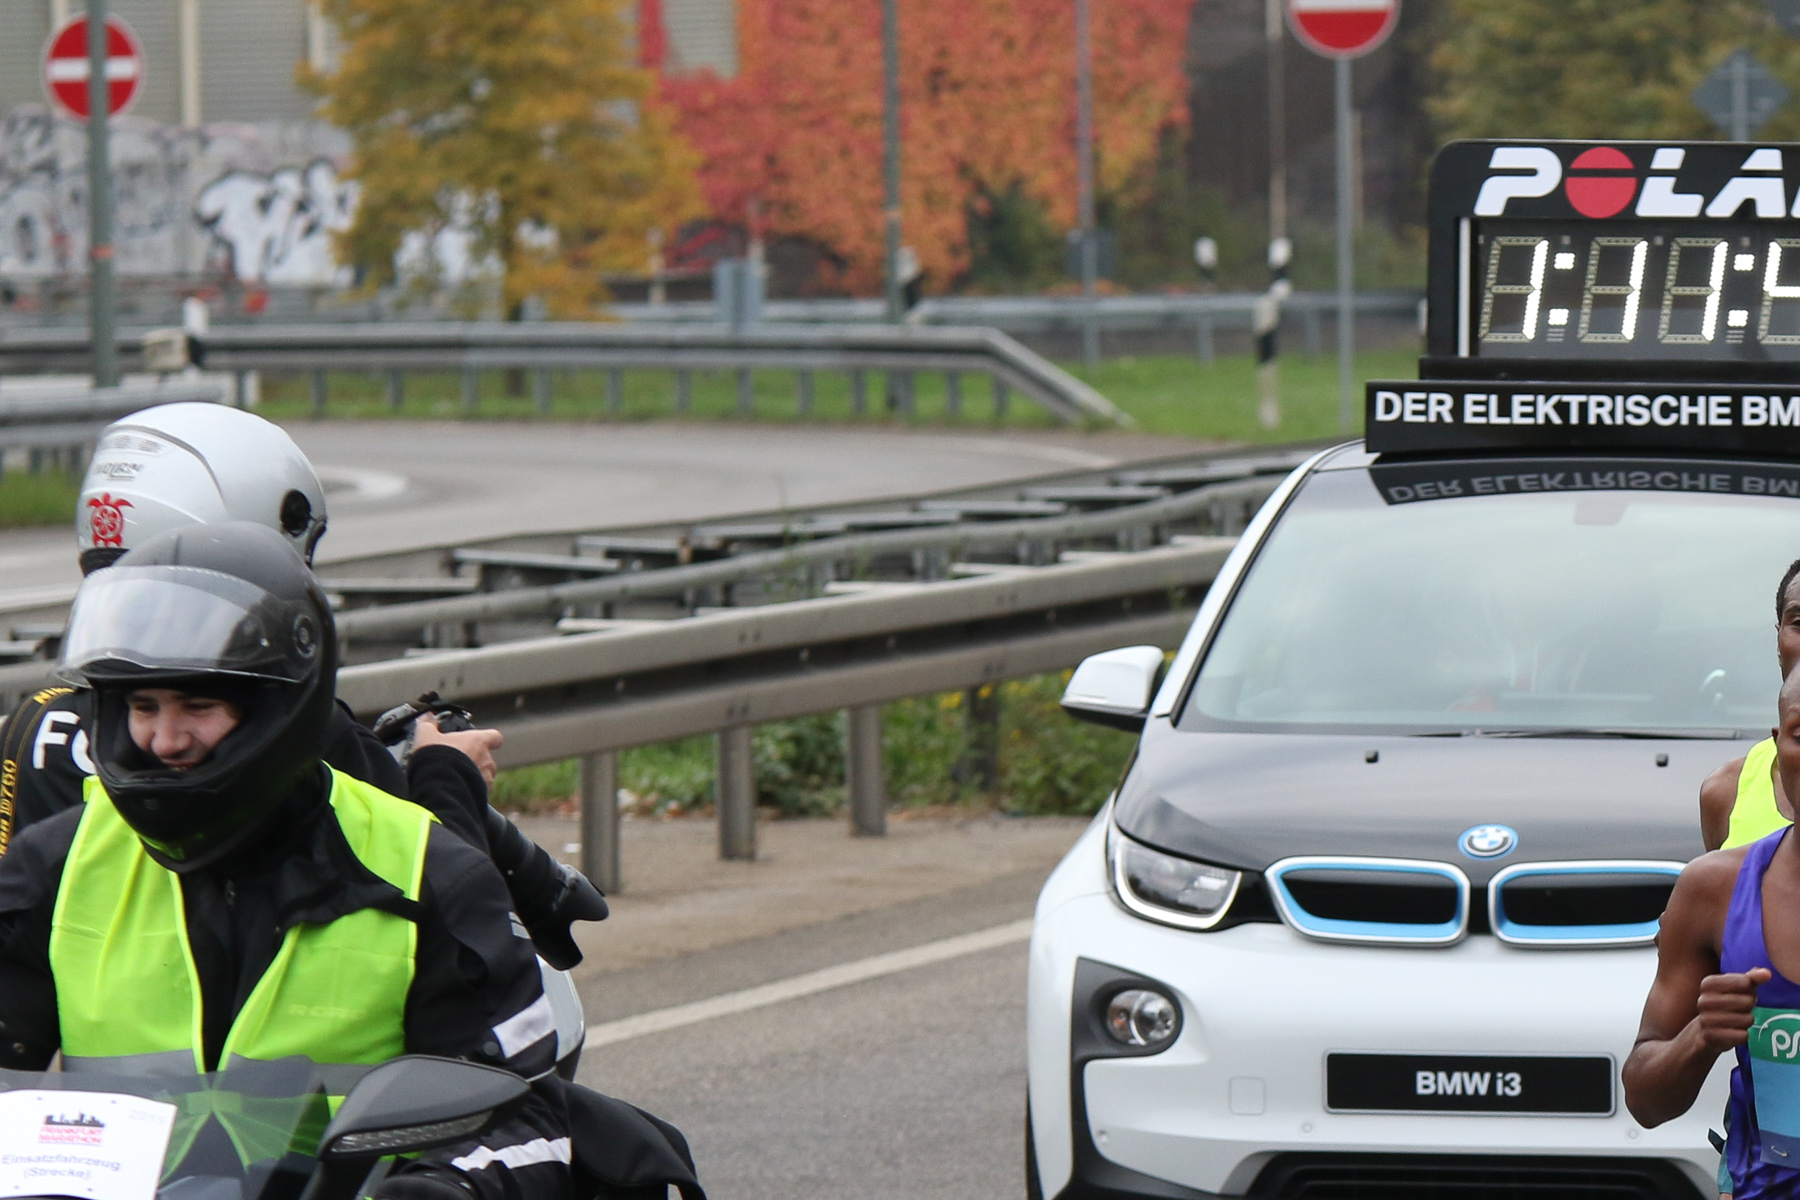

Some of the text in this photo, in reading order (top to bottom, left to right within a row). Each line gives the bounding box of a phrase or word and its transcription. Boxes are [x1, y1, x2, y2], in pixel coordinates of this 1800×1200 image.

[1374, 391, 1454, 424] DER
[1463, 393, 1733, 427] ELEKTRISCHE
[1415, 1070, 1523, 1097] BMW i3
[1, 1153, 123, 1172] Einsatzfahrzeug
